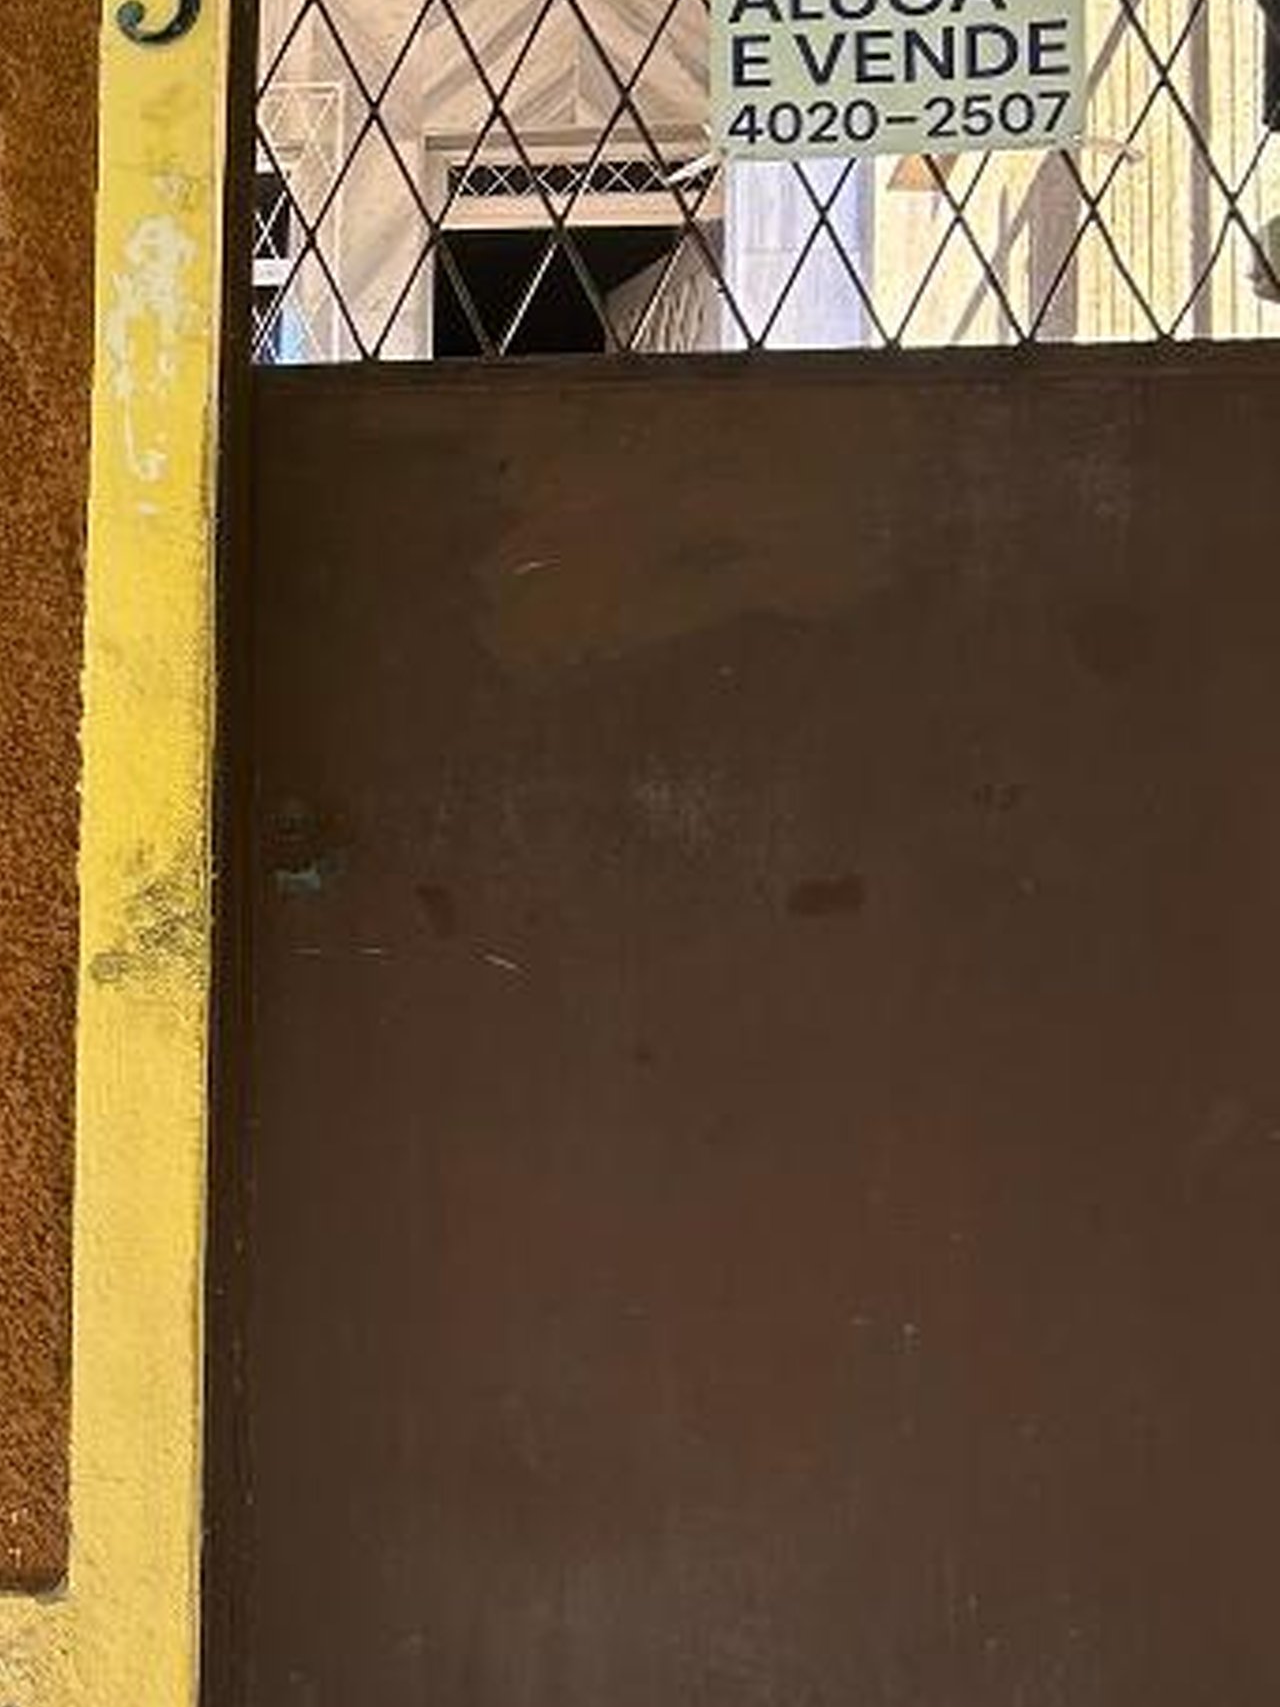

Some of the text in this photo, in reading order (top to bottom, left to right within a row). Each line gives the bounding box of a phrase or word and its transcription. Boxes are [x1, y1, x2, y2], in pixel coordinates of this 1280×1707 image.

[732, 19, 1071, 88] E VENDE
[727, 92, 1071, 144] 4020-2507
